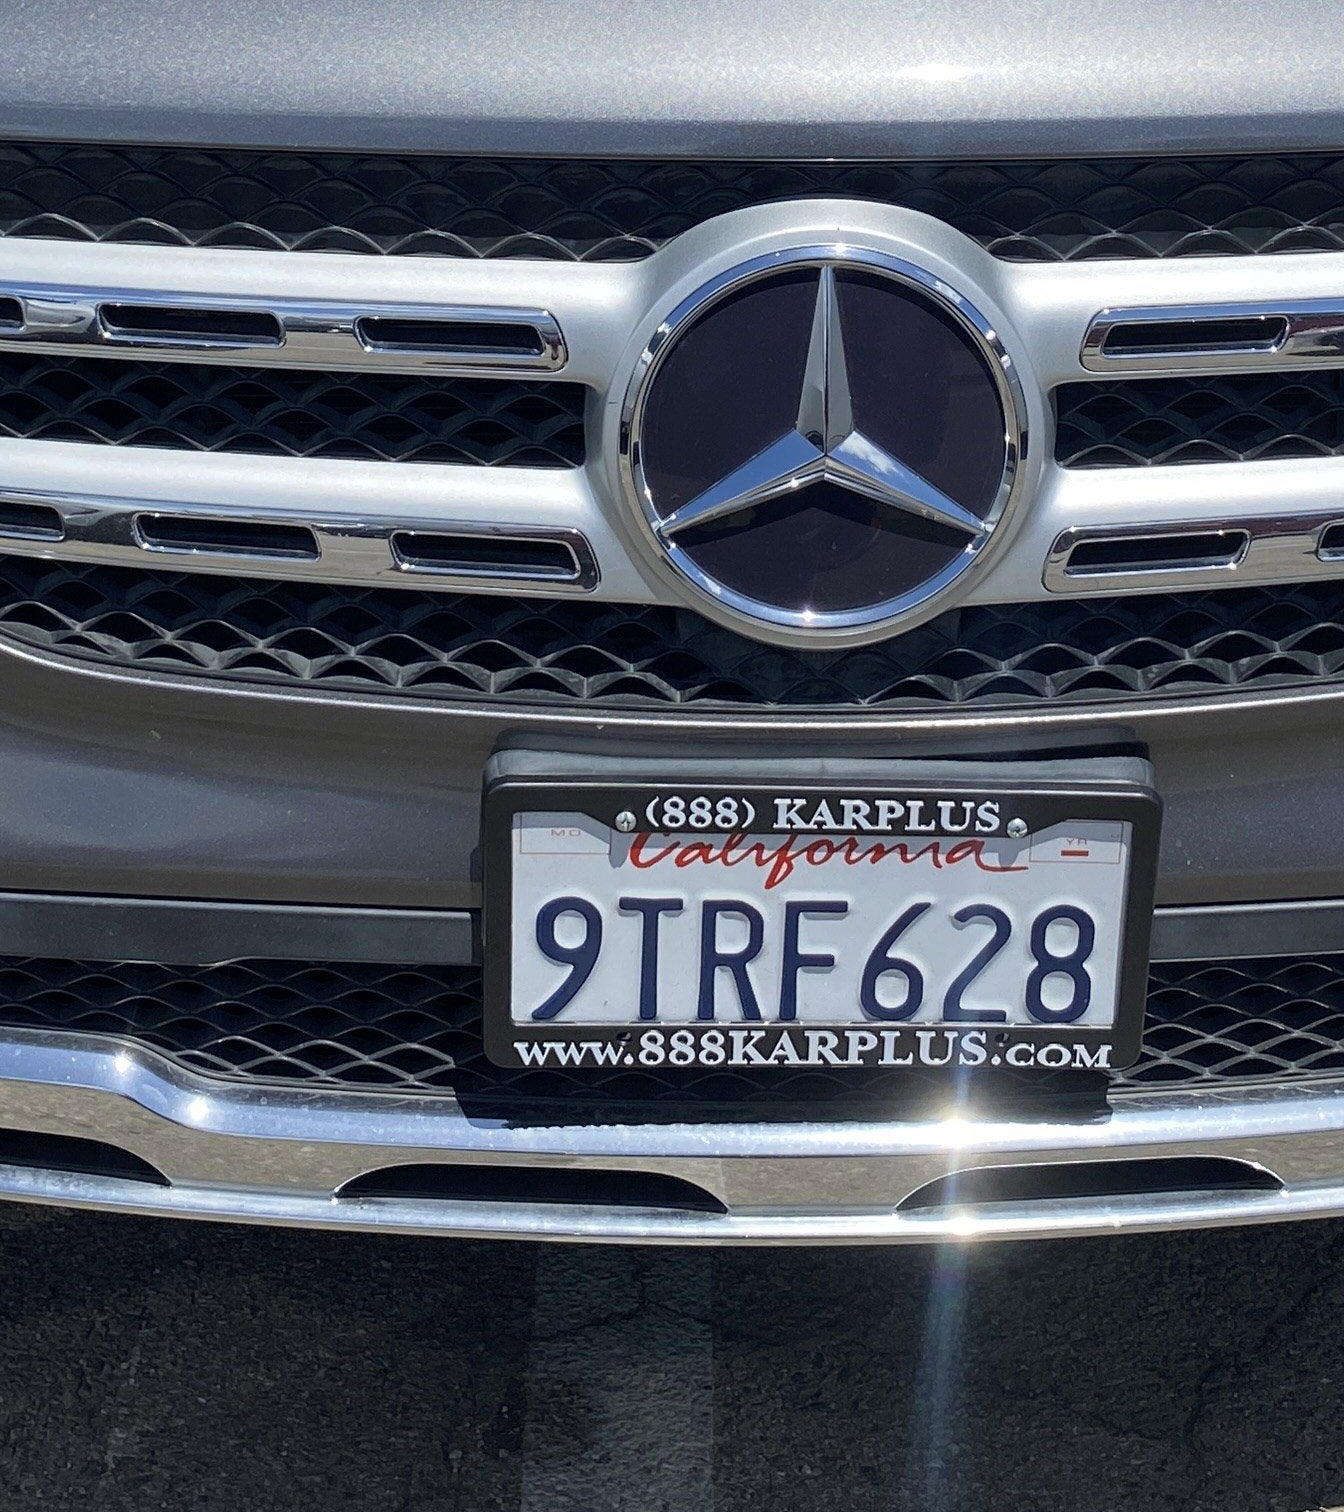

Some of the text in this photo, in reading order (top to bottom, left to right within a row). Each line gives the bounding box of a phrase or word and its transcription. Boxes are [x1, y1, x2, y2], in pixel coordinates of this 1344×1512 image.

[644, 795, 1002, 833] (888) KARPLUS
[530, 895, 1097, 1024] 9TRF628
